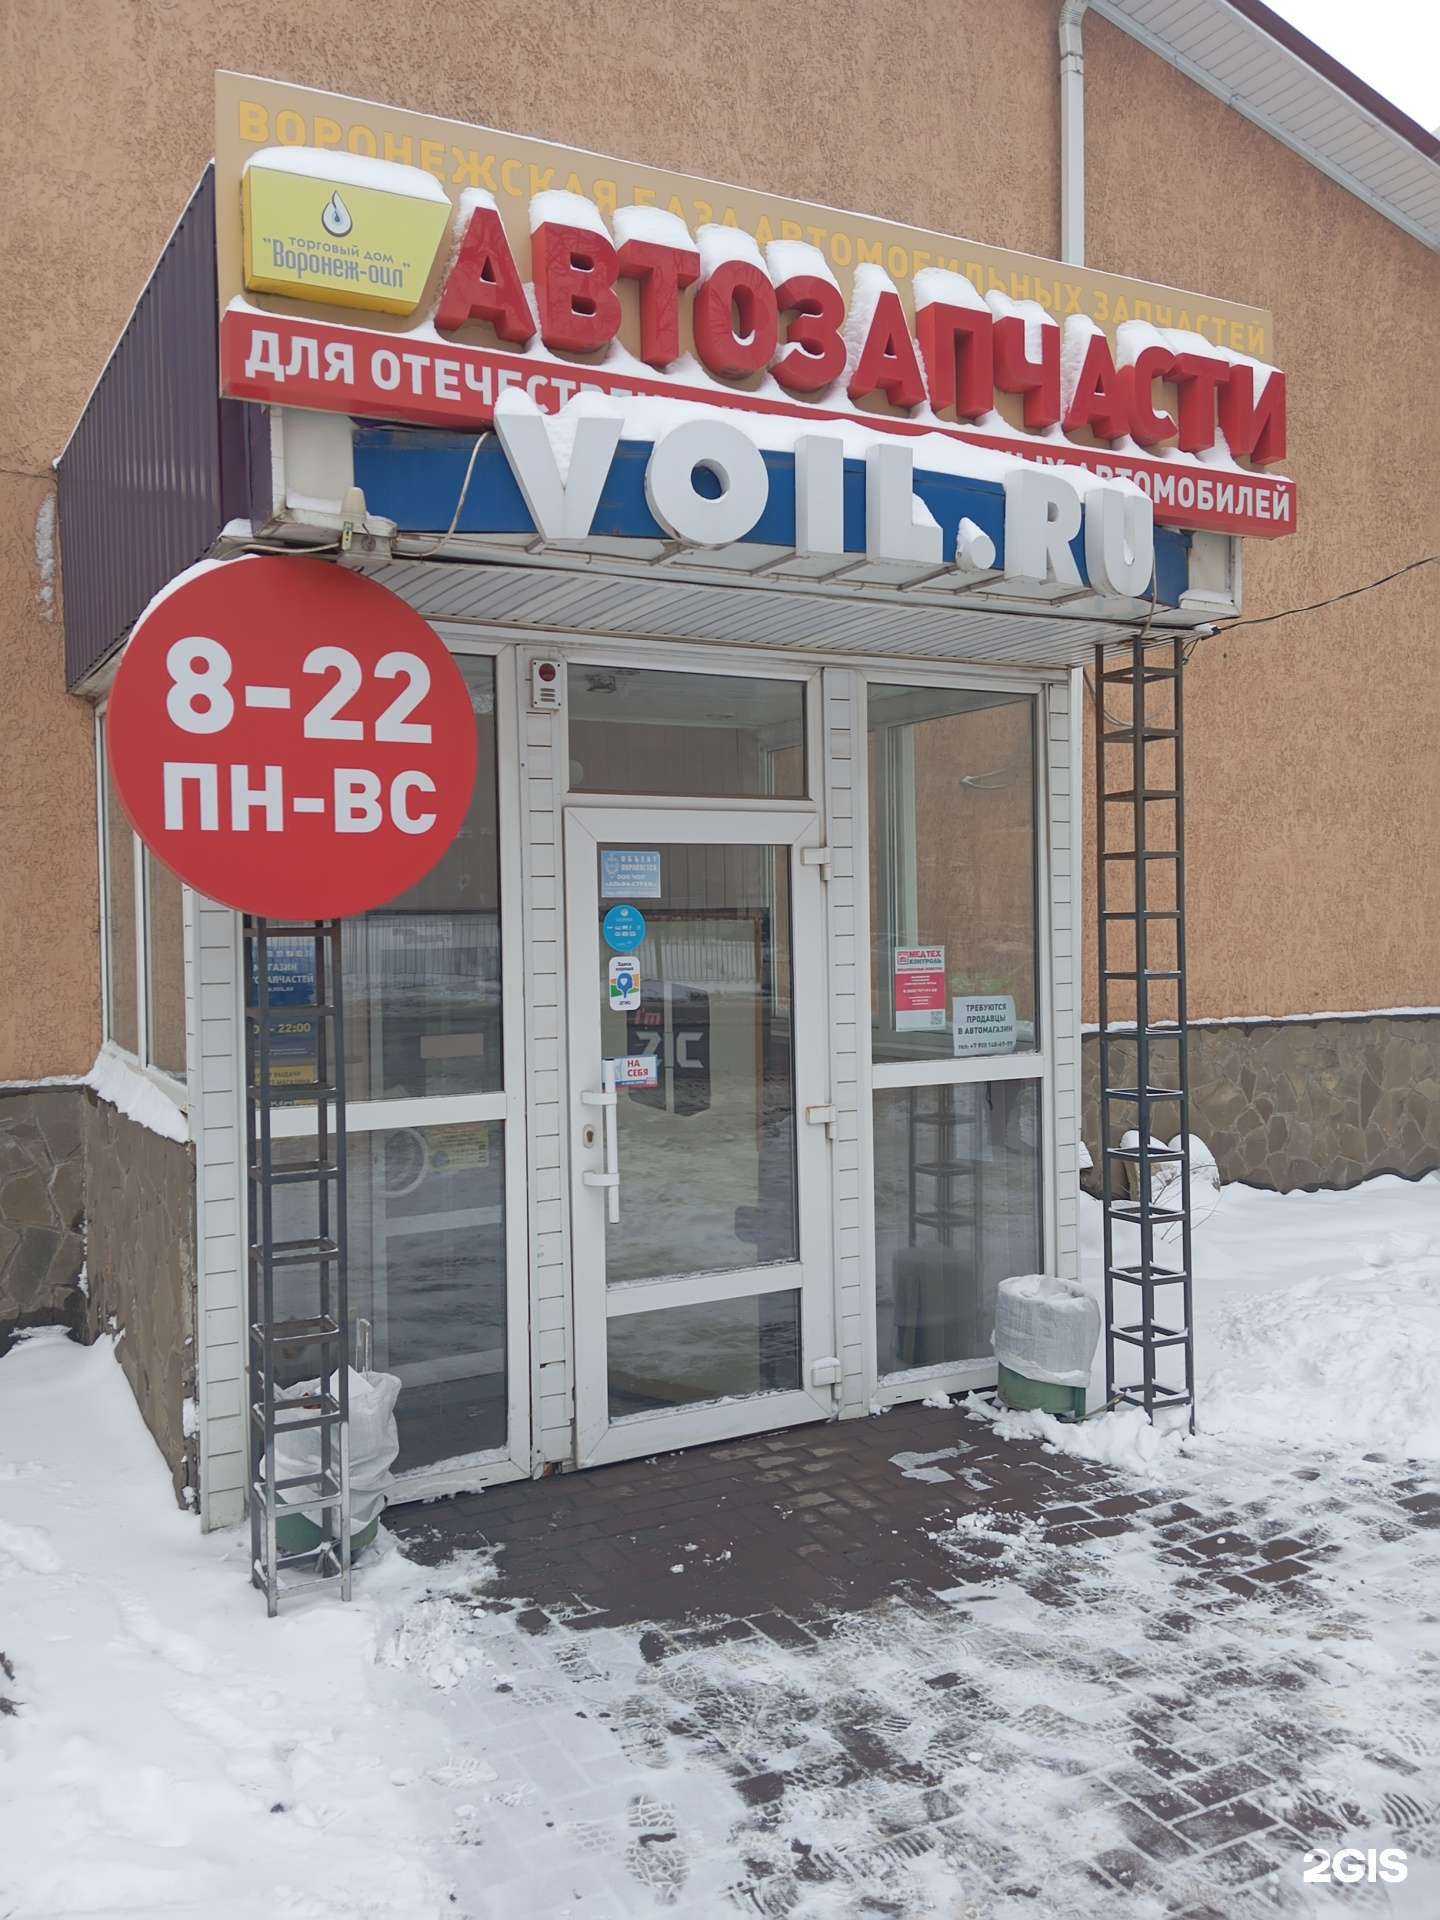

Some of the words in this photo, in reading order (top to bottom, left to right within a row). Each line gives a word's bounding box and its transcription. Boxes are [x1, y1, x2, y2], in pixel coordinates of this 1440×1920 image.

[434, 205, 1287, 466] АВТОЗАПЧАСТИ
[244, 330, 356, 388] ДЛЯ
[1079, 462, 1290, 522] ВТОМОБИЛЕЙ
[494, 411, 1154, 599] VOIL.RU
[165, 635, 433, 744] 8-22
[163, 762, 437, 835] ПН-ВС
[278, 1022, 311, 1034] 22:00
[966, 1003, 1007, 1012] ТРЕБУЮТСЯ
[966, 1014, 1007, 1023] ПРОДАВЦЫ
[627, 1059, 641, 1067] НА
[627, 1068, 649, 1078] СЕБЯ
